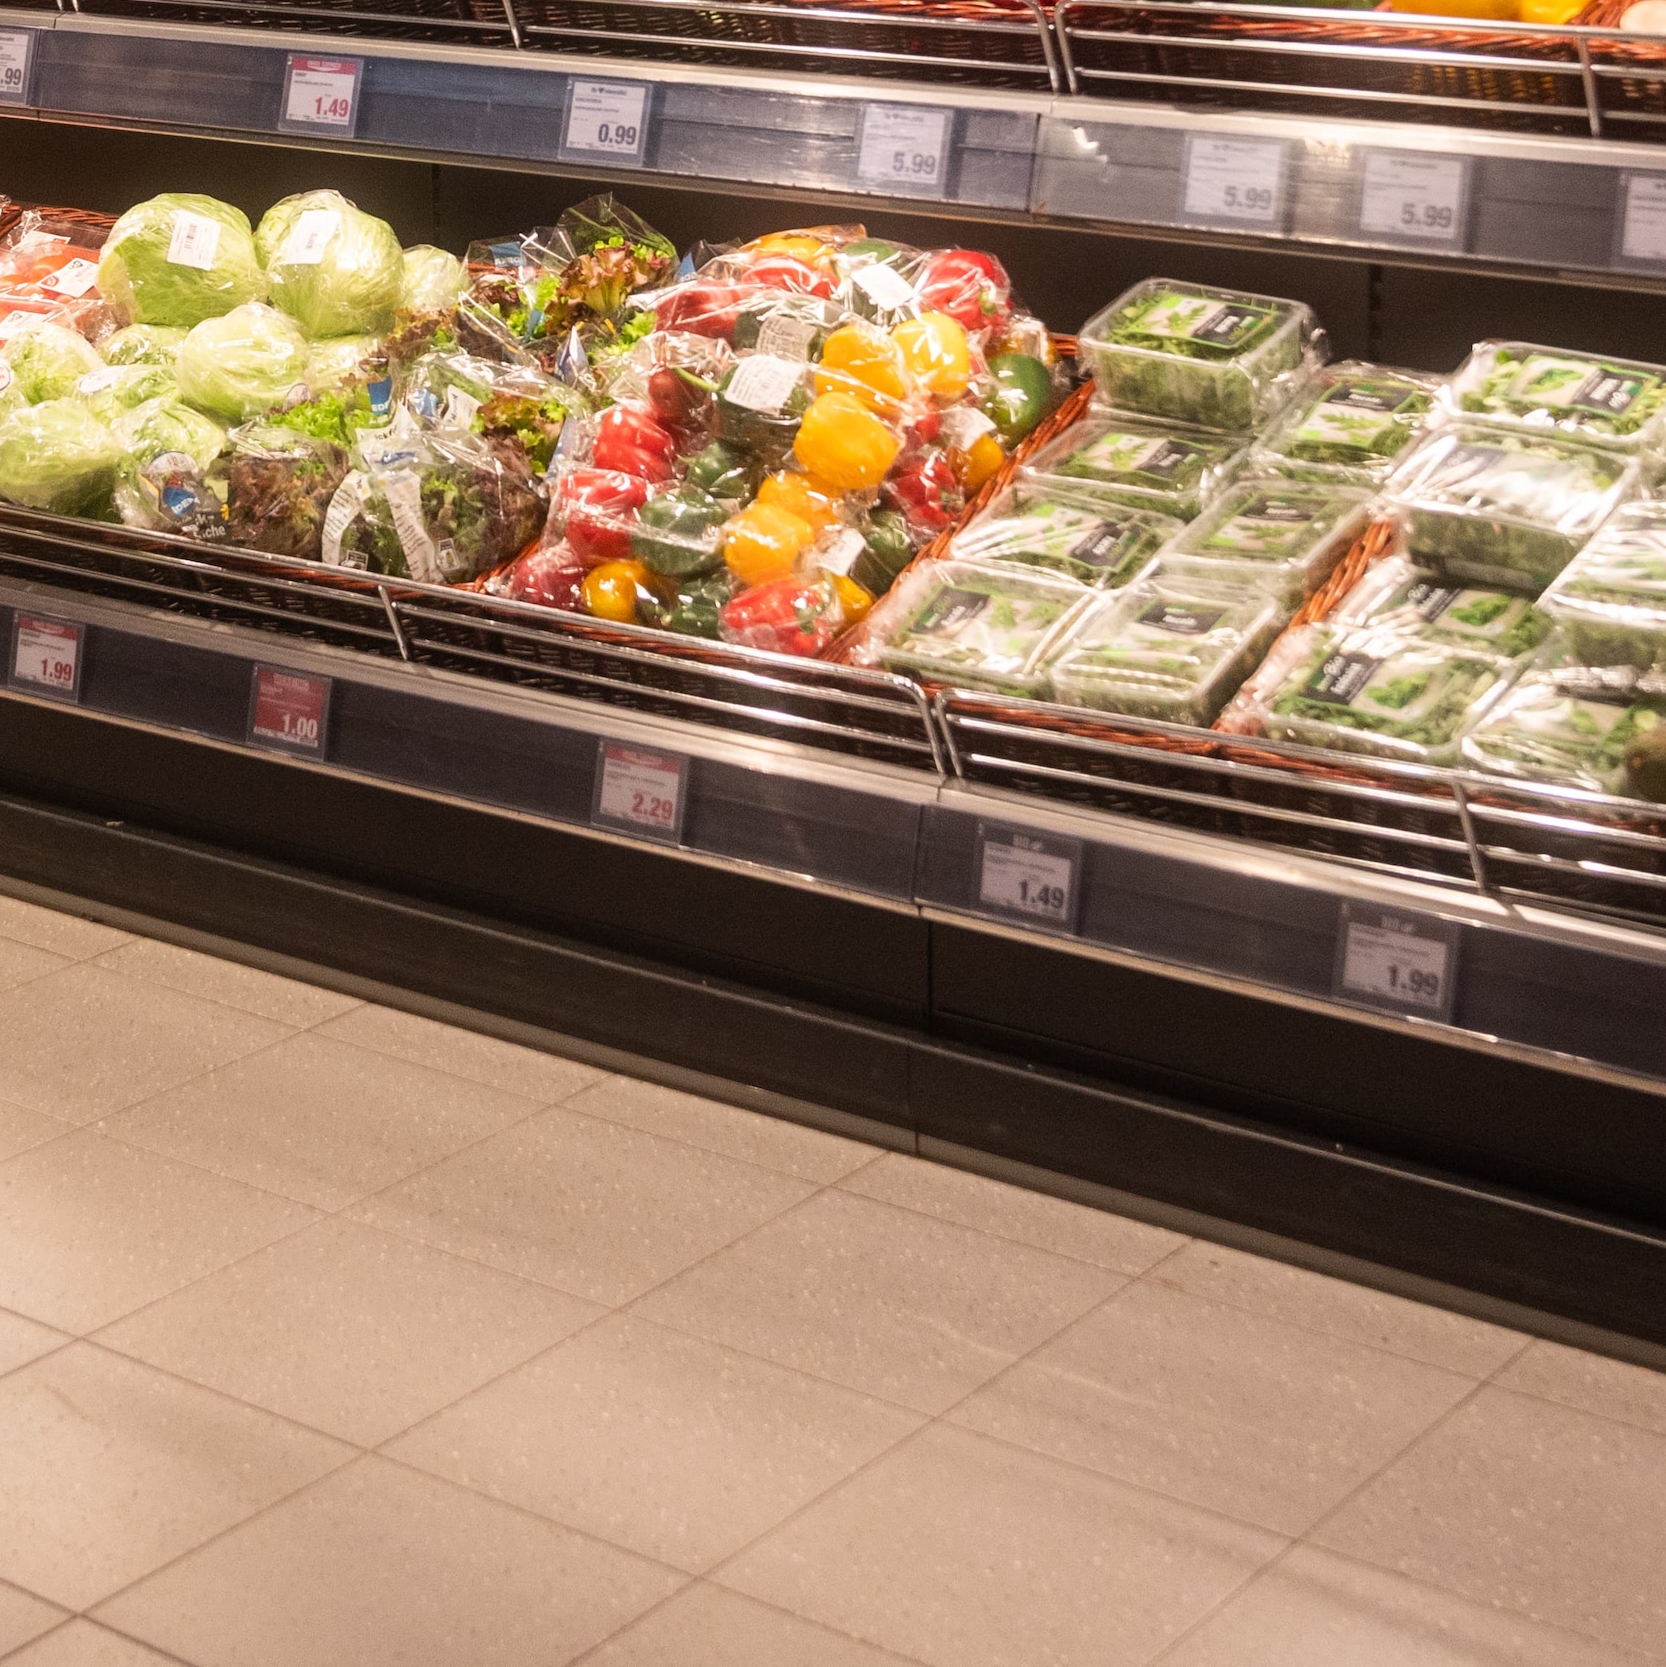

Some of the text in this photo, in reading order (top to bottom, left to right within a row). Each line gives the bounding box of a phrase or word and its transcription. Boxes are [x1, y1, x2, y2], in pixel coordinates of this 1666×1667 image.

[315, 97, 348, 118] 1.49
[598, 123, 637, 146] 0.99
[893, 151, 935, 174] 5.99
[1223, 186, 1272, 210] 5.99
[1401, 202, 1453, 229] 5.99
[41, 658, 73, 682] 1.99
[282, 714, 317, 740] 1.00
[632, 792, 674, 820] 2.29
[1019, 879, 1065, 910] 1.49
[1387, 964, 1440, 997] 1.99
